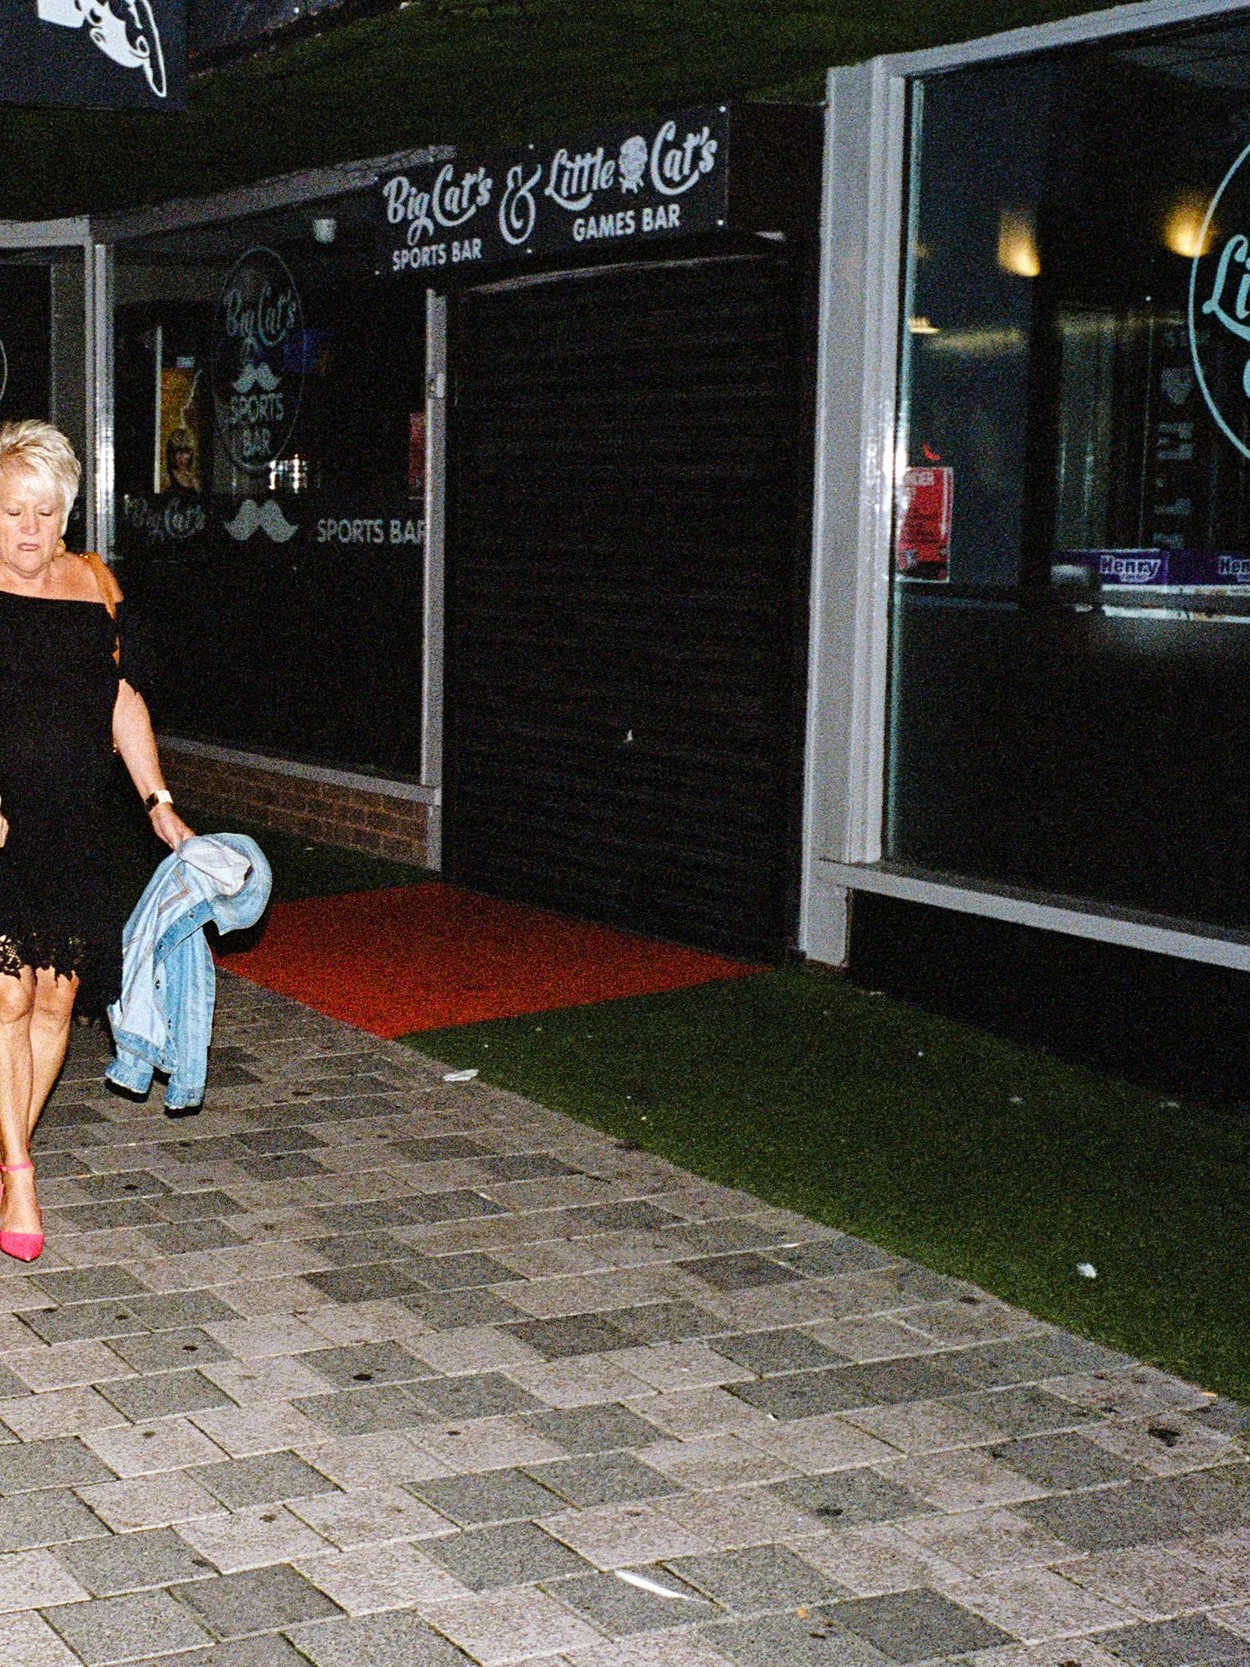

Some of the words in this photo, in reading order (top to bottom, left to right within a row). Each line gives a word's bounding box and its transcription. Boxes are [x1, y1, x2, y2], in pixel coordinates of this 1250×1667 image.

[383, 176, 434, 246] Big
[432, 163, 493, 227] Cat's
[499, 164, 542, 245] &
[544, 147, 615, 211] Little
[651, 119, 719, 196] Cat's
[573, 209, 636, 243] GAMES
[642, 203, 681, 231] BAR
[391, 242, 446, 272] SPORTS
[451, 237, 482, 261] BAR
[317, 519, 384, 544] SPORTS
[1100, 555, 1161, 578] Henry
